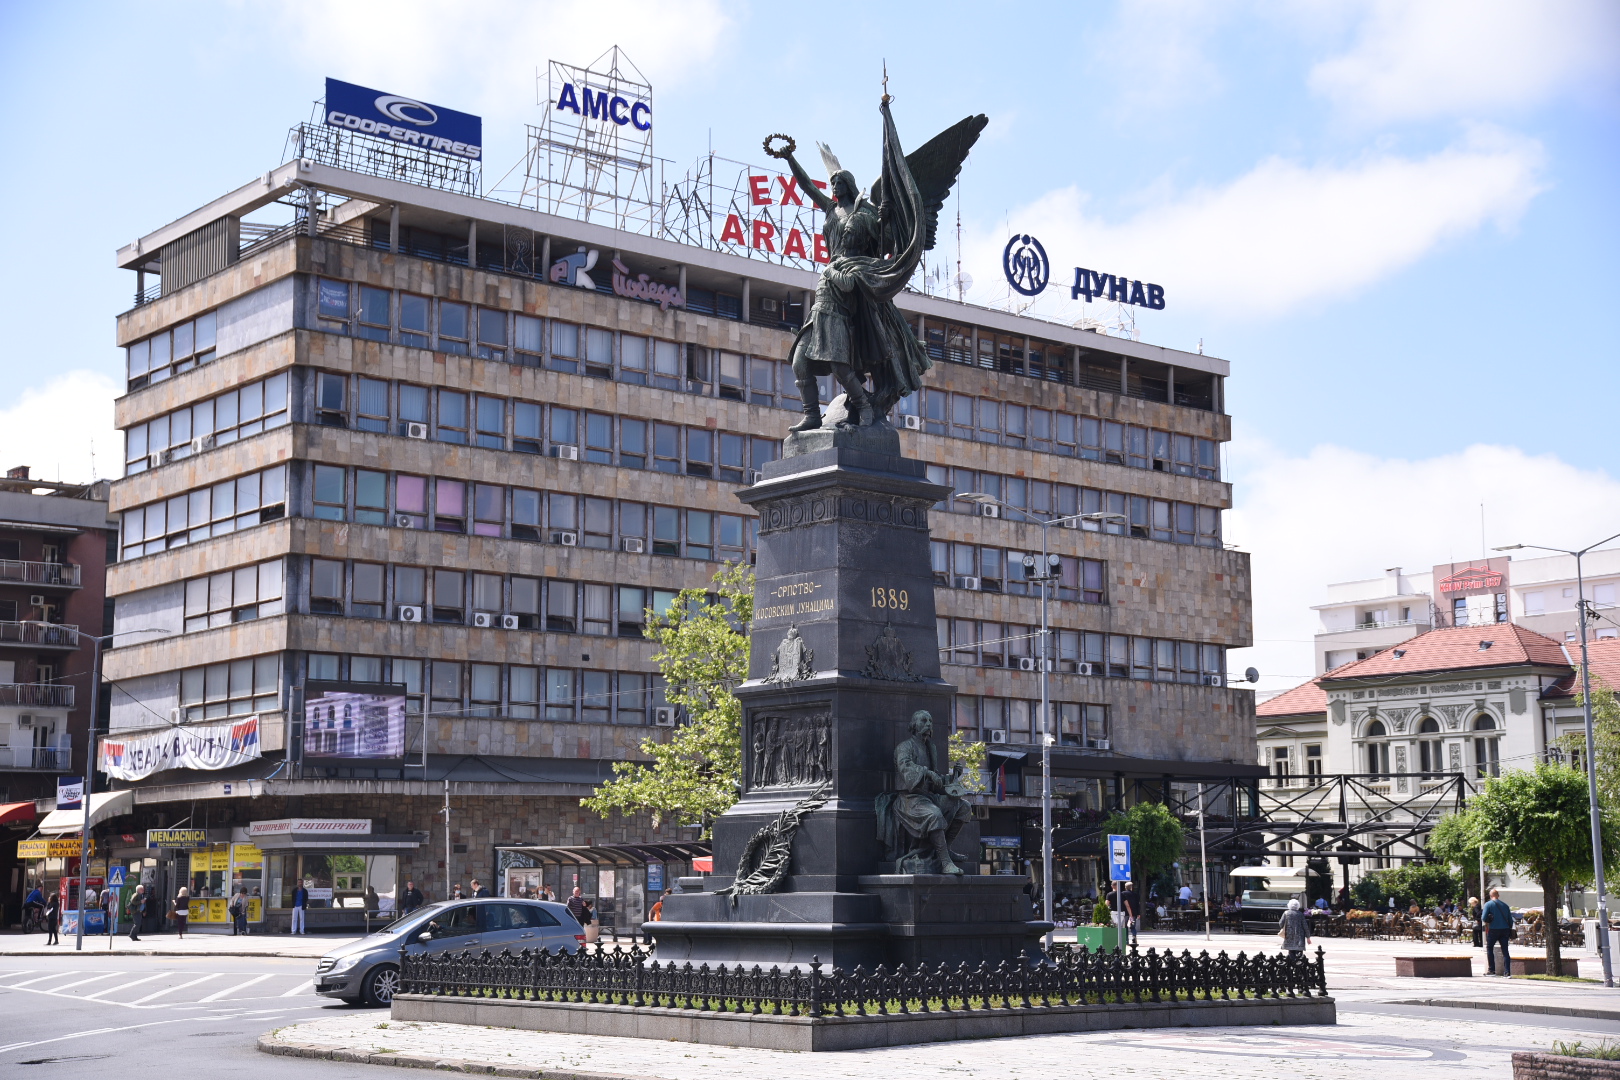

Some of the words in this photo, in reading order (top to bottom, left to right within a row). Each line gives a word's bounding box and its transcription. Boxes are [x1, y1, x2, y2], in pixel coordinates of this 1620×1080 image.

[327, 110, 482, 159] COOPERTIRES
[1071, 266, 1166, 310] ДУНАВ
[755, 603, 795, 620] КОСОВСКИМ
[796, 598, 835, 615] ЈУНАЦИМА
